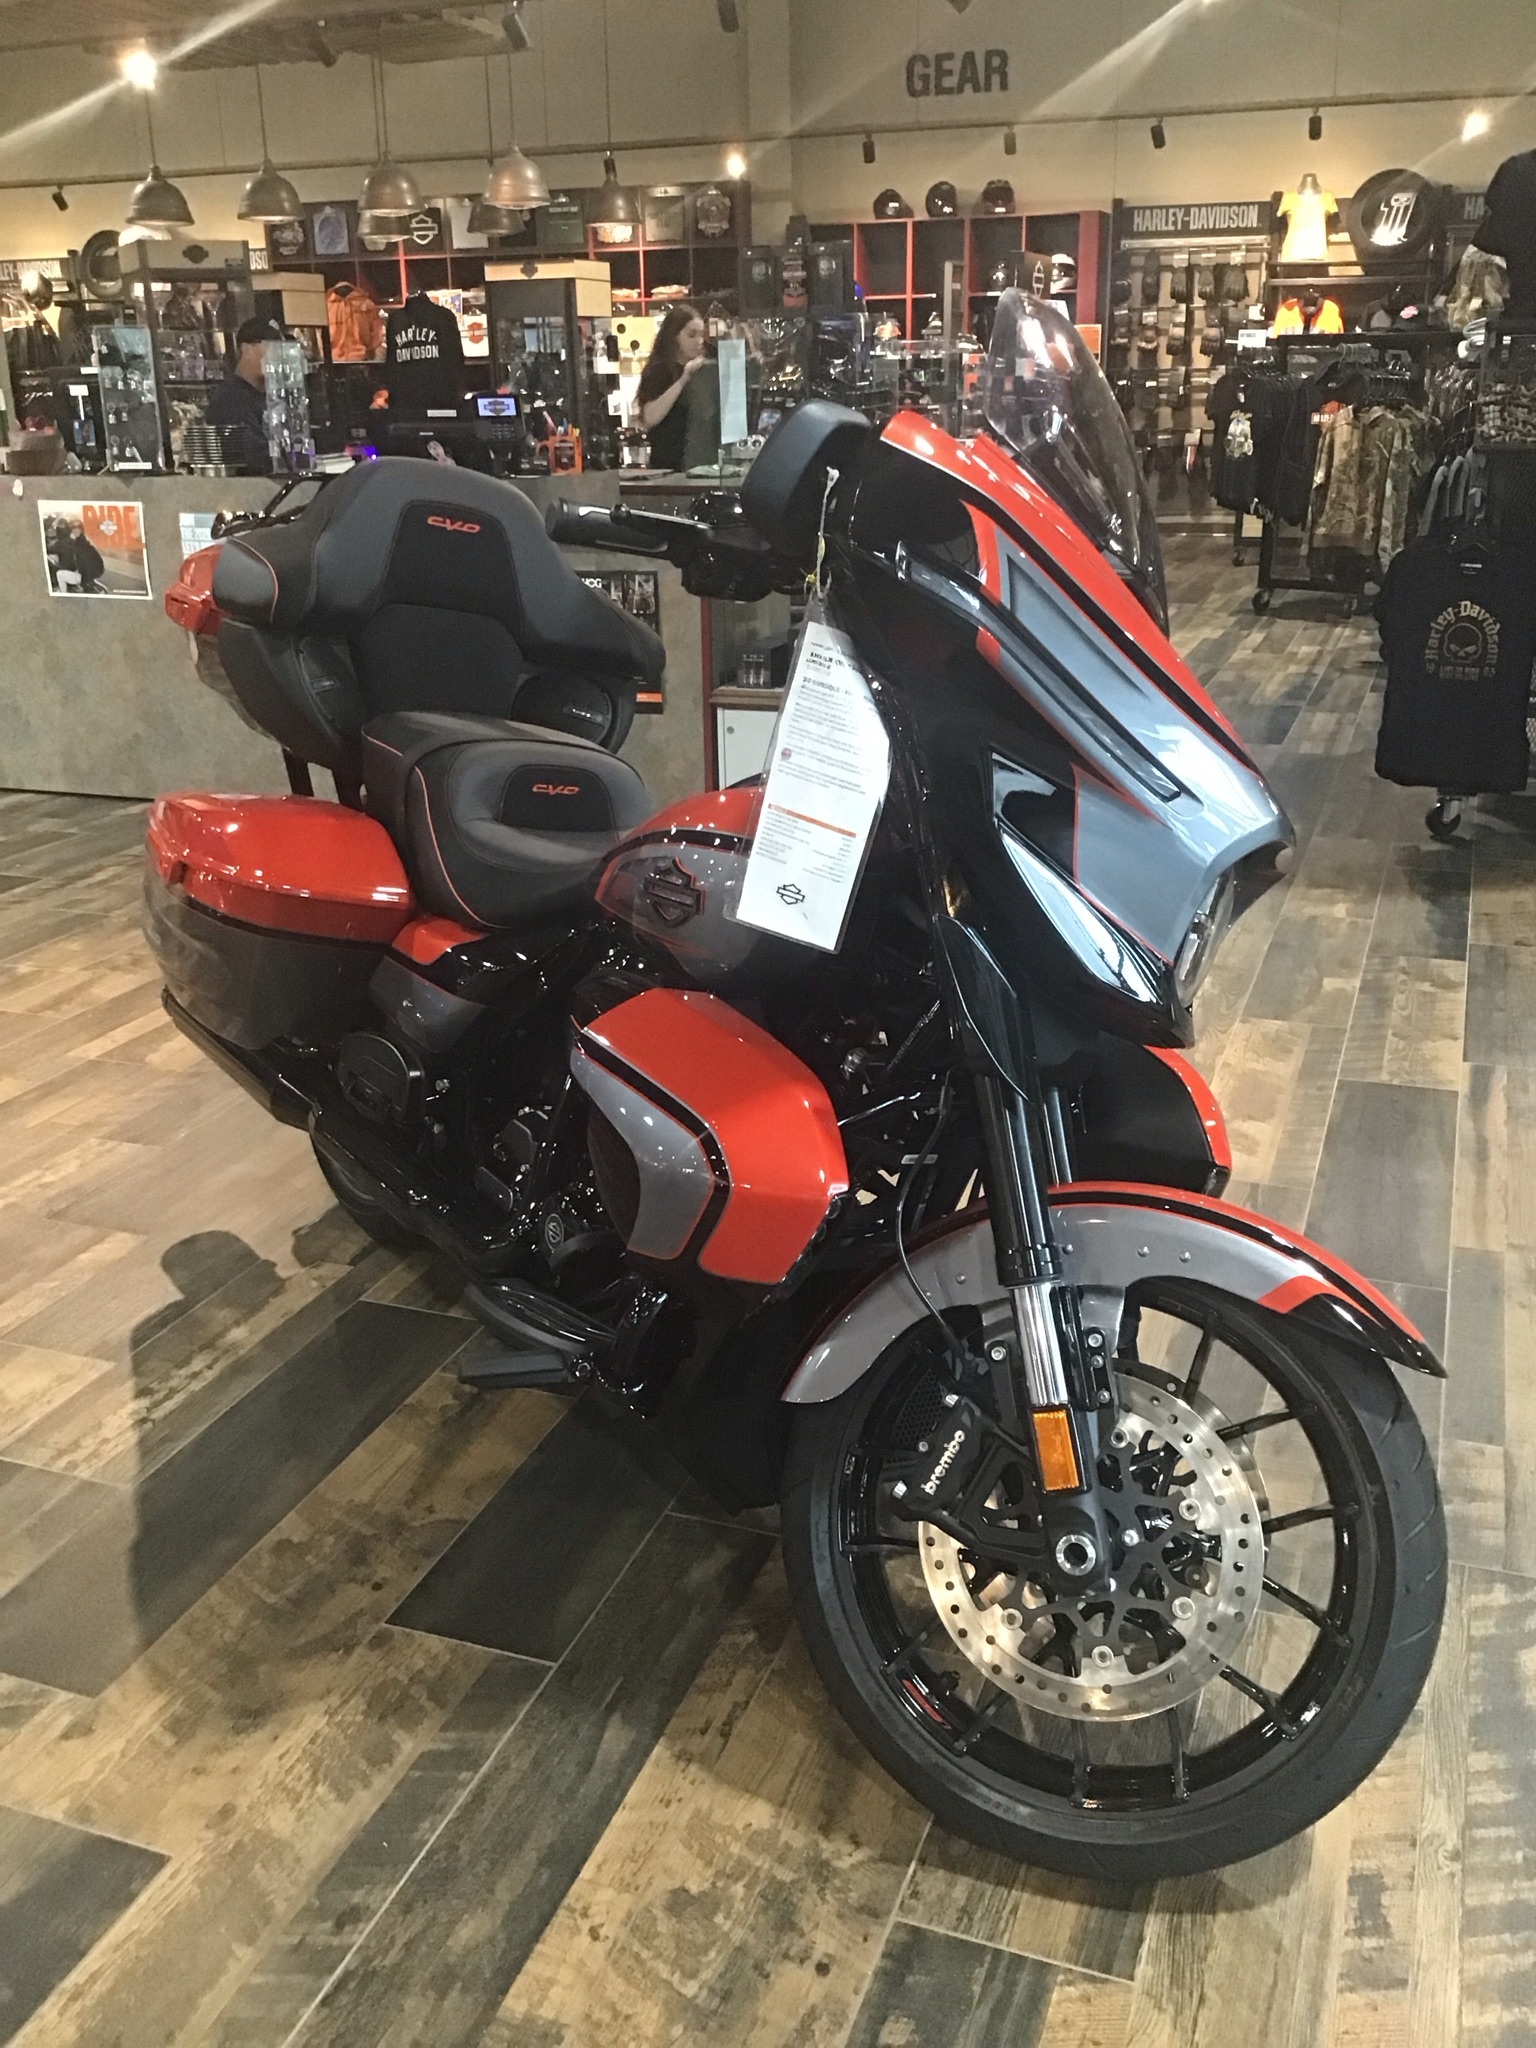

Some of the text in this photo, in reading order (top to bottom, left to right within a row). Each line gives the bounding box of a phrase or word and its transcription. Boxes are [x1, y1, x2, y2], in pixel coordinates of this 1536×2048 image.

[905, 48, 1009, 98] GEAR
[1133, 204, 1259, 232] HARLEY-DAVIDSON
[396, 345, 440, 363] DAVIDSON
[82, 504, 138, 552] RIDE
[427, 515, 481, 534] CVO
[1424, 600, 1501, 664] Harley-Davidson
[532, 784, 580, 796] CVO
[920, 1429, 965, 1496] brembo
